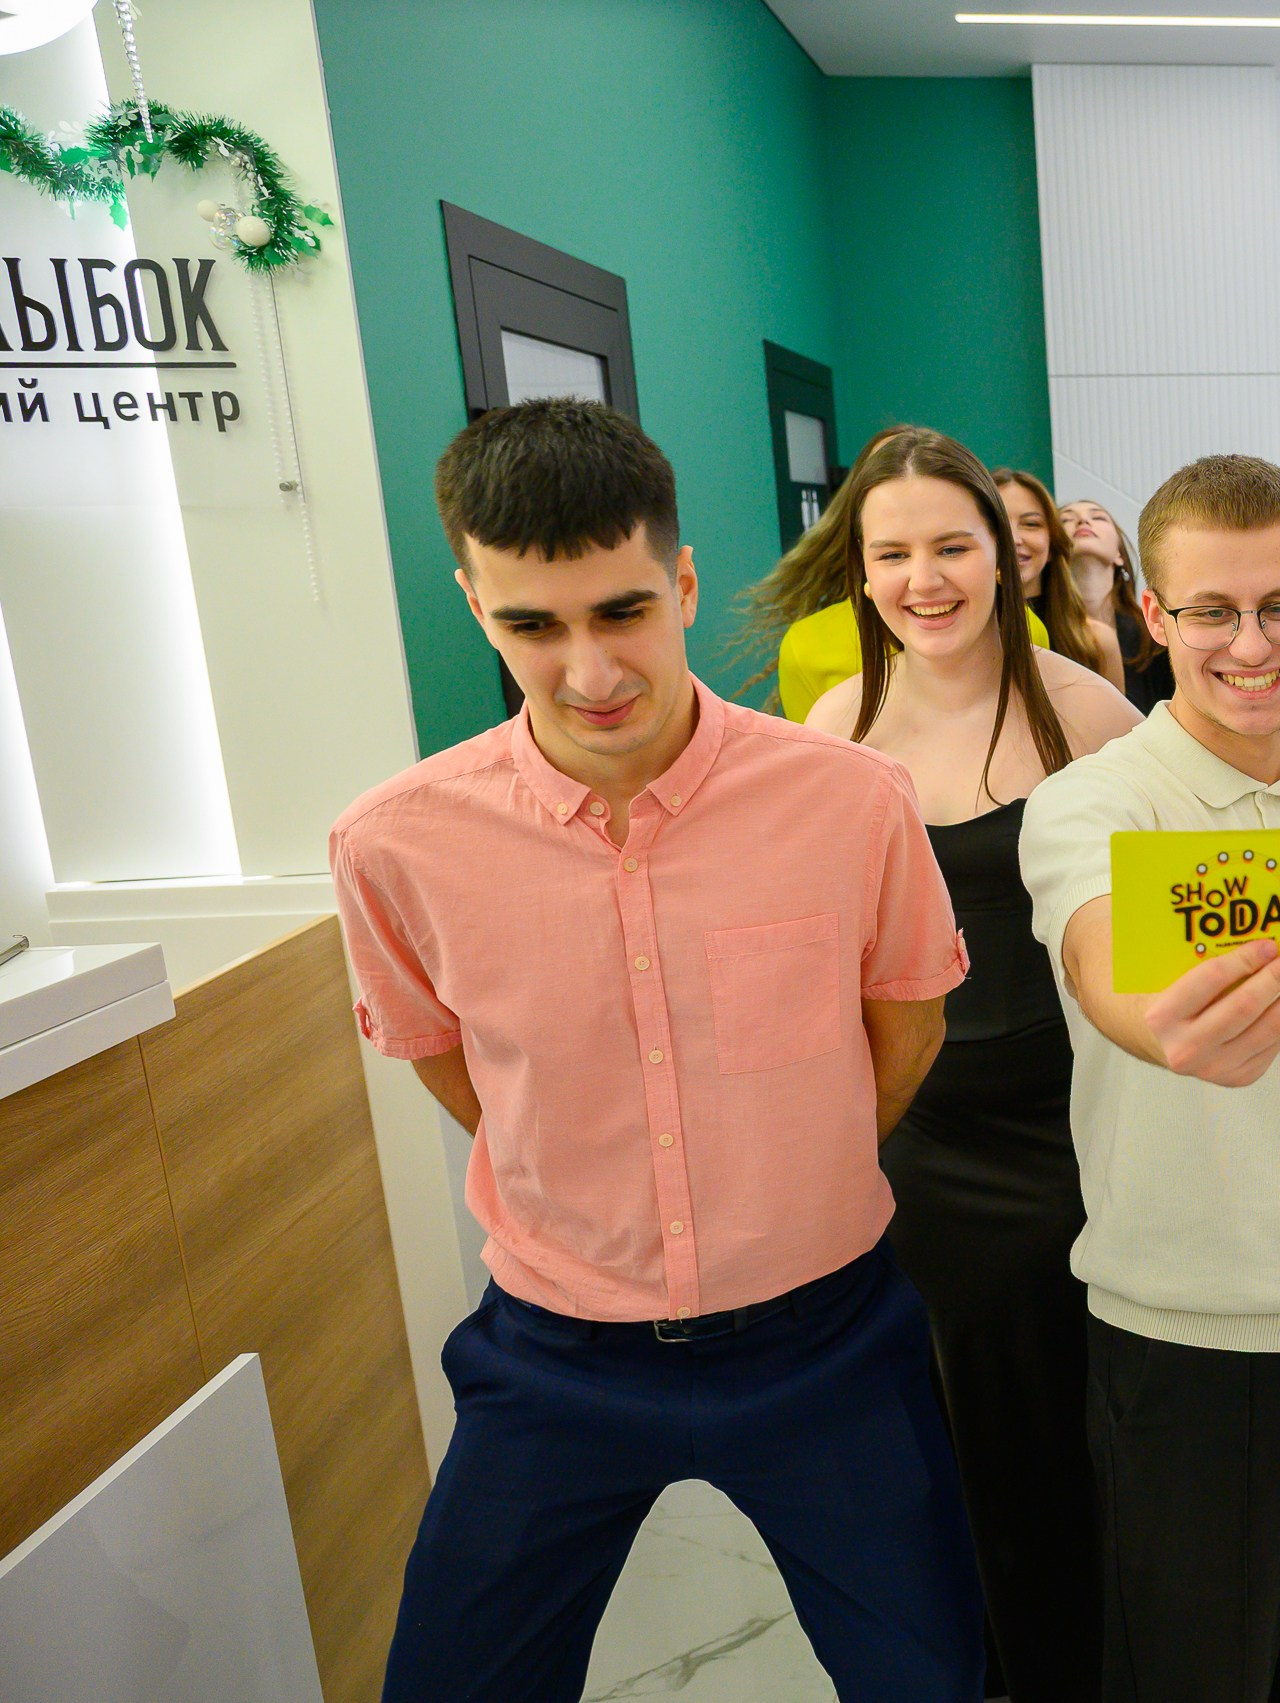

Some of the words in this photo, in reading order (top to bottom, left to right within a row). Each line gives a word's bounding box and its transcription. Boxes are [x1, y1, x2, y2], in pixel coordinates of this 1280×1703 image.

[0, 257, 229, 352] ЫБОК
[73, 390, 241, 432] центр
[1170, 875, 1249, 909] SHOW
